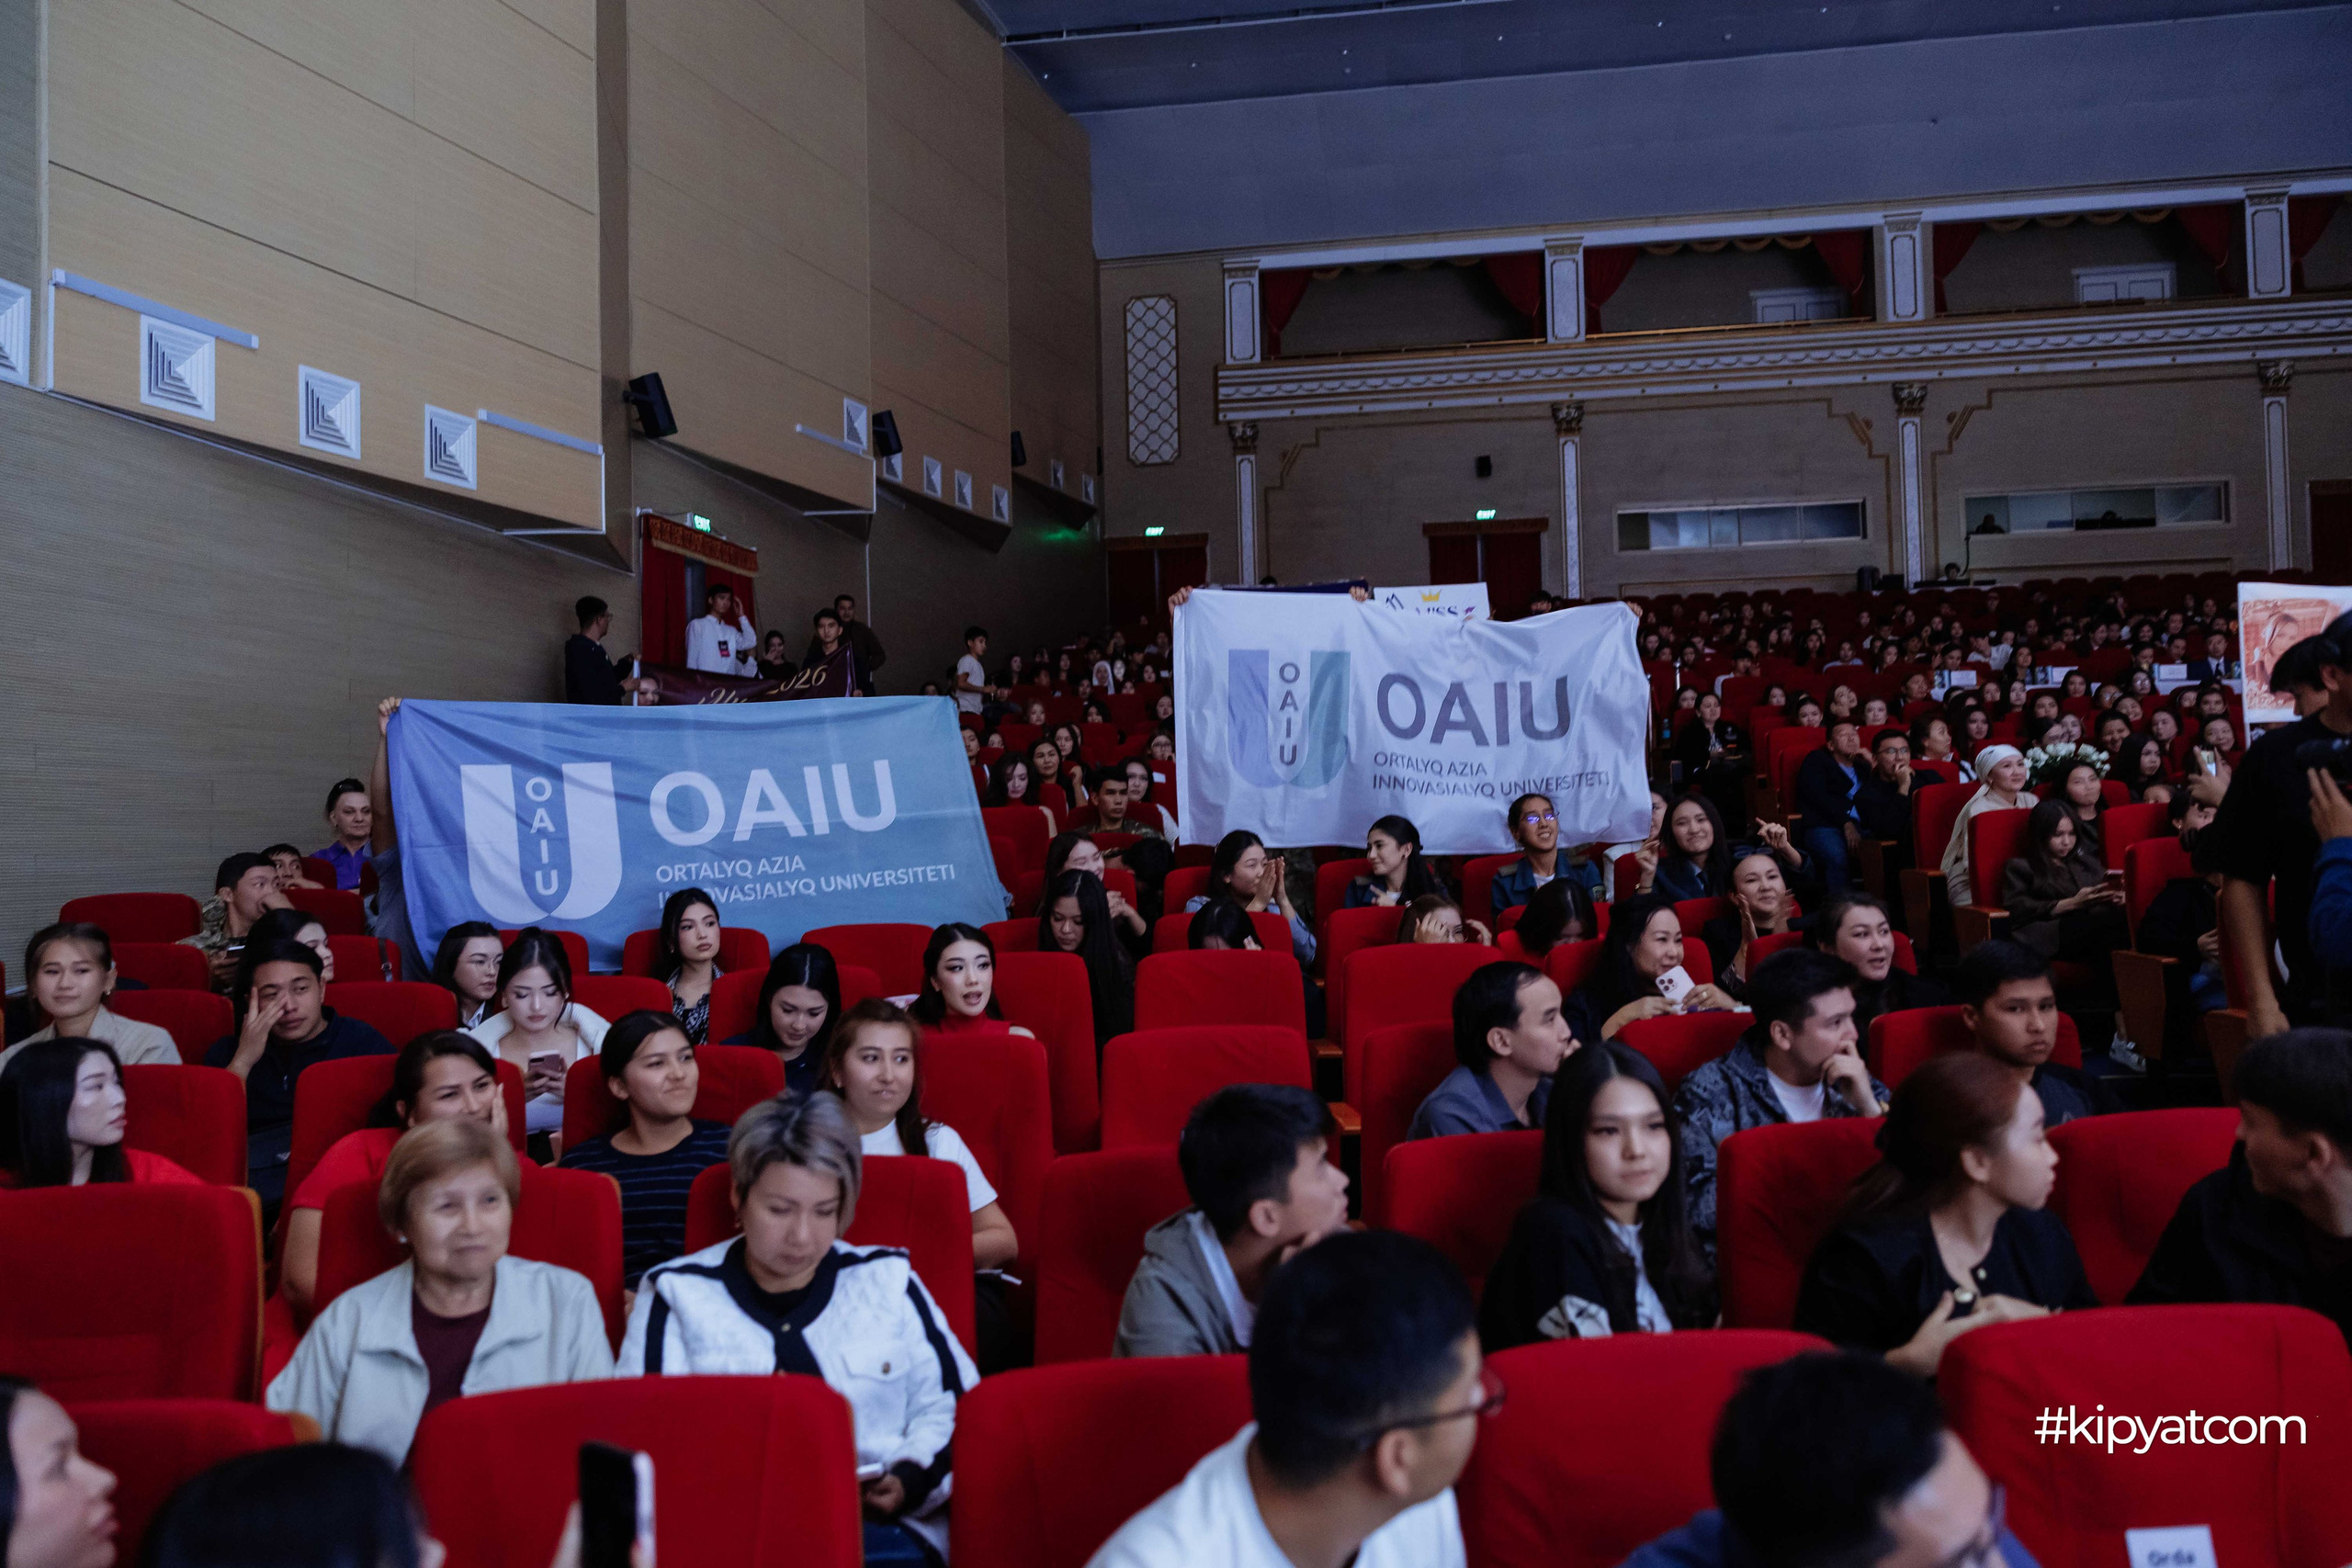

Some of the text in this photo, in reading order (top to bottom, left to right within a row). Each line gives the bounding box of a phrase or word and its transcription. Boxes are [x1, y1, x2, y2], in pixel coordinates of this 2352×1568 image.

[1279, 661, 1301, 766] OAIU
[1376, 673, 1571, 747] OAIU
[1373, 774, 1496, 798] INNOVASIALYQ
[1374, 751, 1487, 777] ORTALYQ AZIA
[650, 760, 897, 846] OAIU
[526, 776, 560, 896] OAIU
[655, 854, 807, 884] ORTALYQ AZIA
[658, 863, 956, 909] IOVASIALYQ UNIVERSITETI
